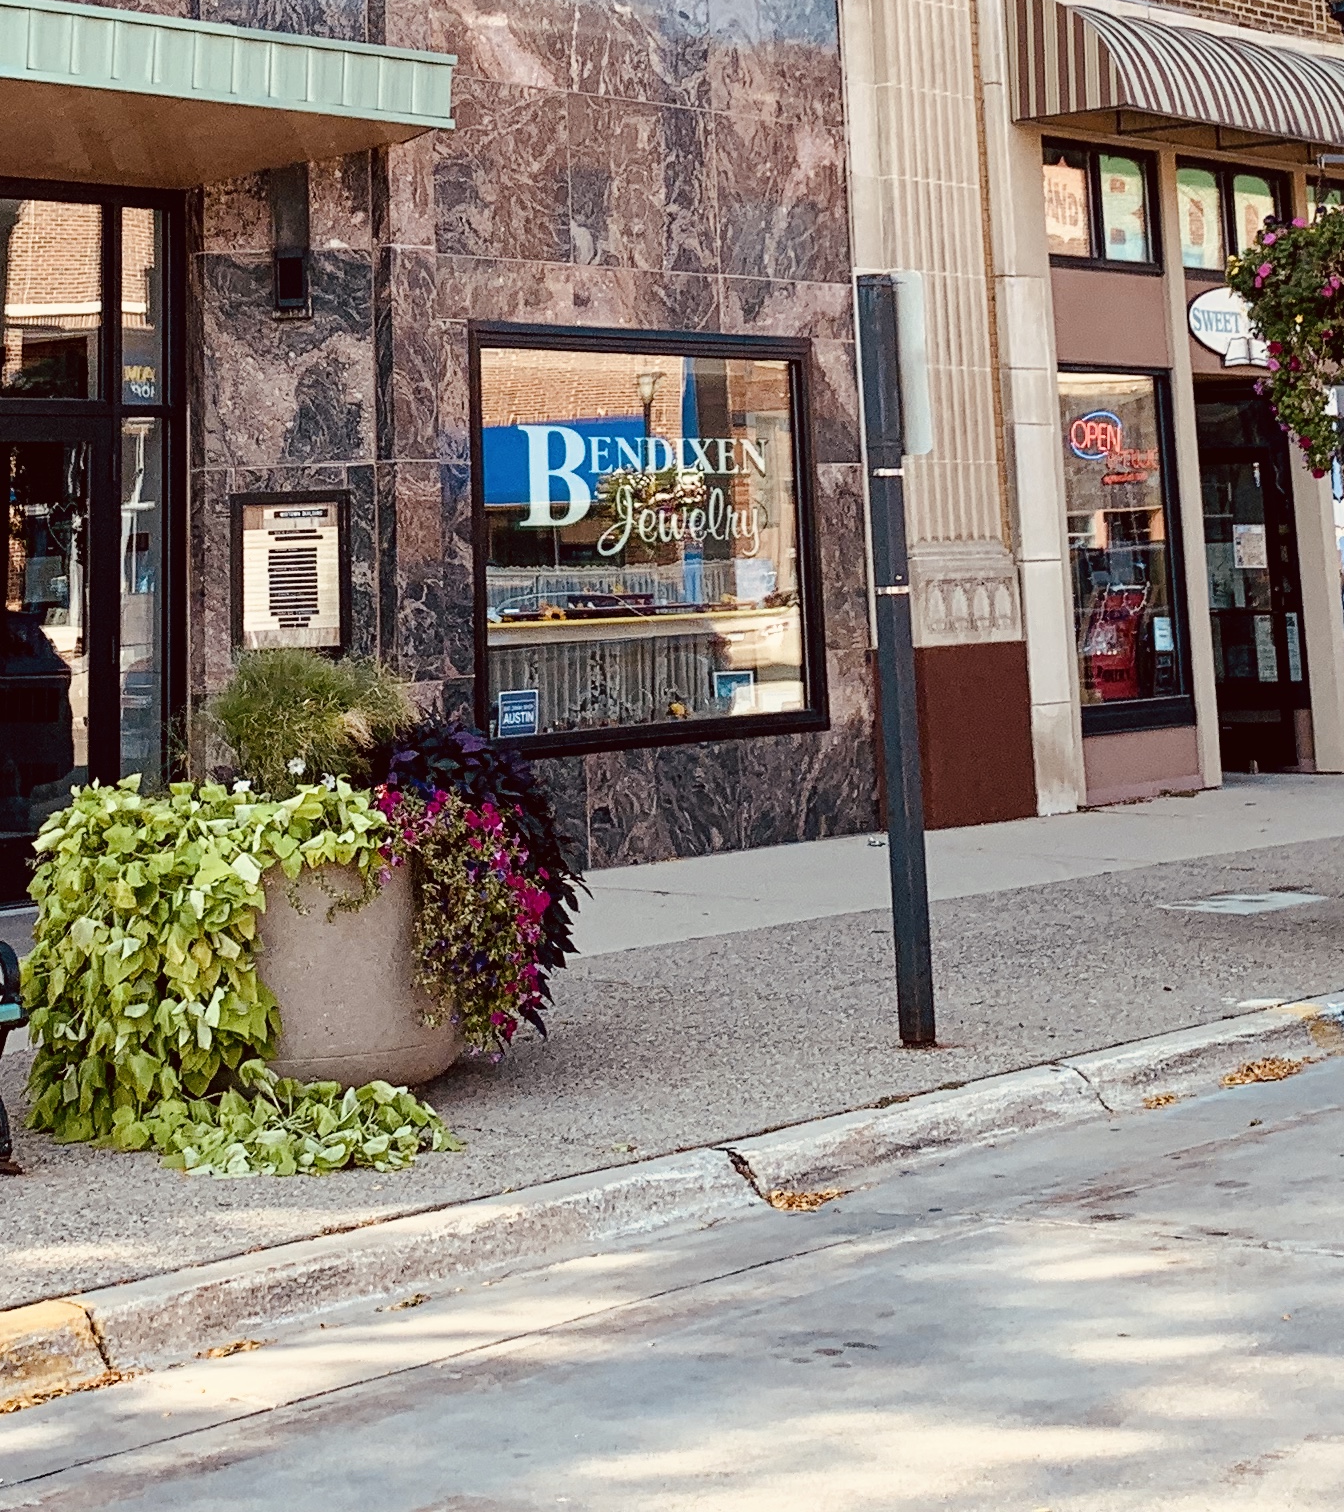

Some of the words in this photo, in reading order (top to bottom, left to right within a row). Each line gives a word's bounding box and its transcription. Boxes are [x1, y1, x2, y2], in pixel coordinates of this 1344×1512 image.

[1192, 307, 1242, 334] SWEET
[1071, 420, 1122, 453] OPEN
[517, 425, 769, 527] BENDIXEN
[597, 486, 763, 557] Jewelry
[502, 711, 535, 725] AUSTIN
